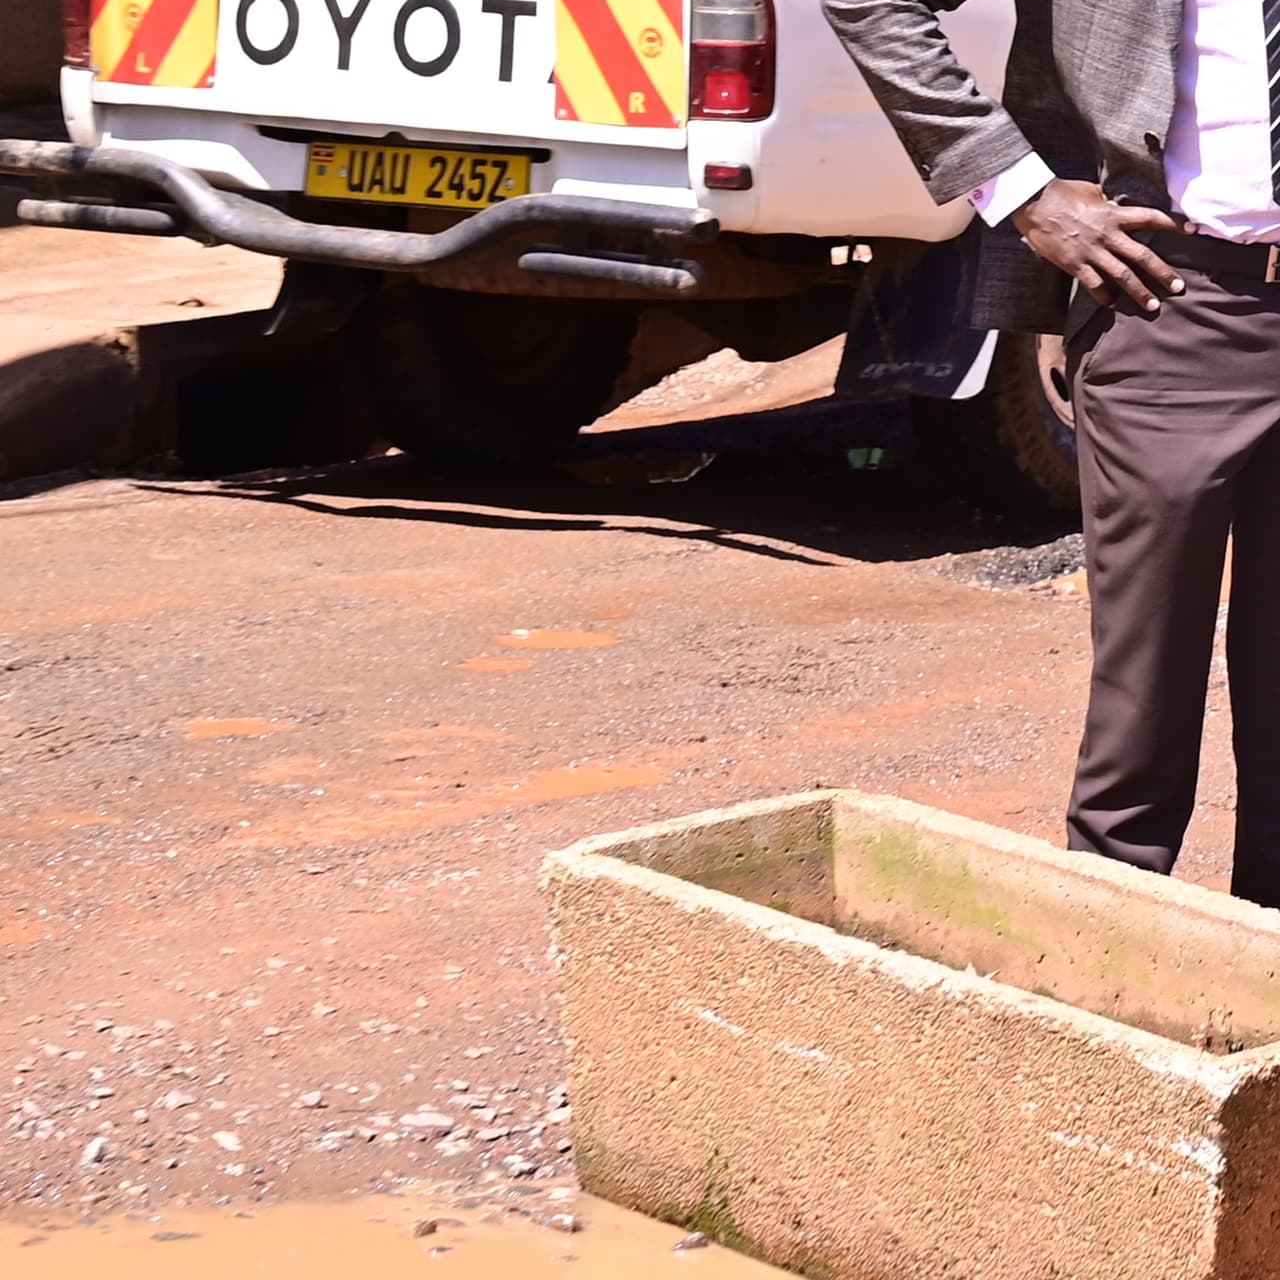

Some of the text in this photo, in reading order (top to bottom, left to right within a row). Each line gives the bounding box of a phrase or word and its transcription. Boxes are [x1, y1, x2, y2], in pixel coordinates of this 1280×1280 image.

[628, 91, 647, 114] R
[347, 150, 509, 203] UAU 245Z
